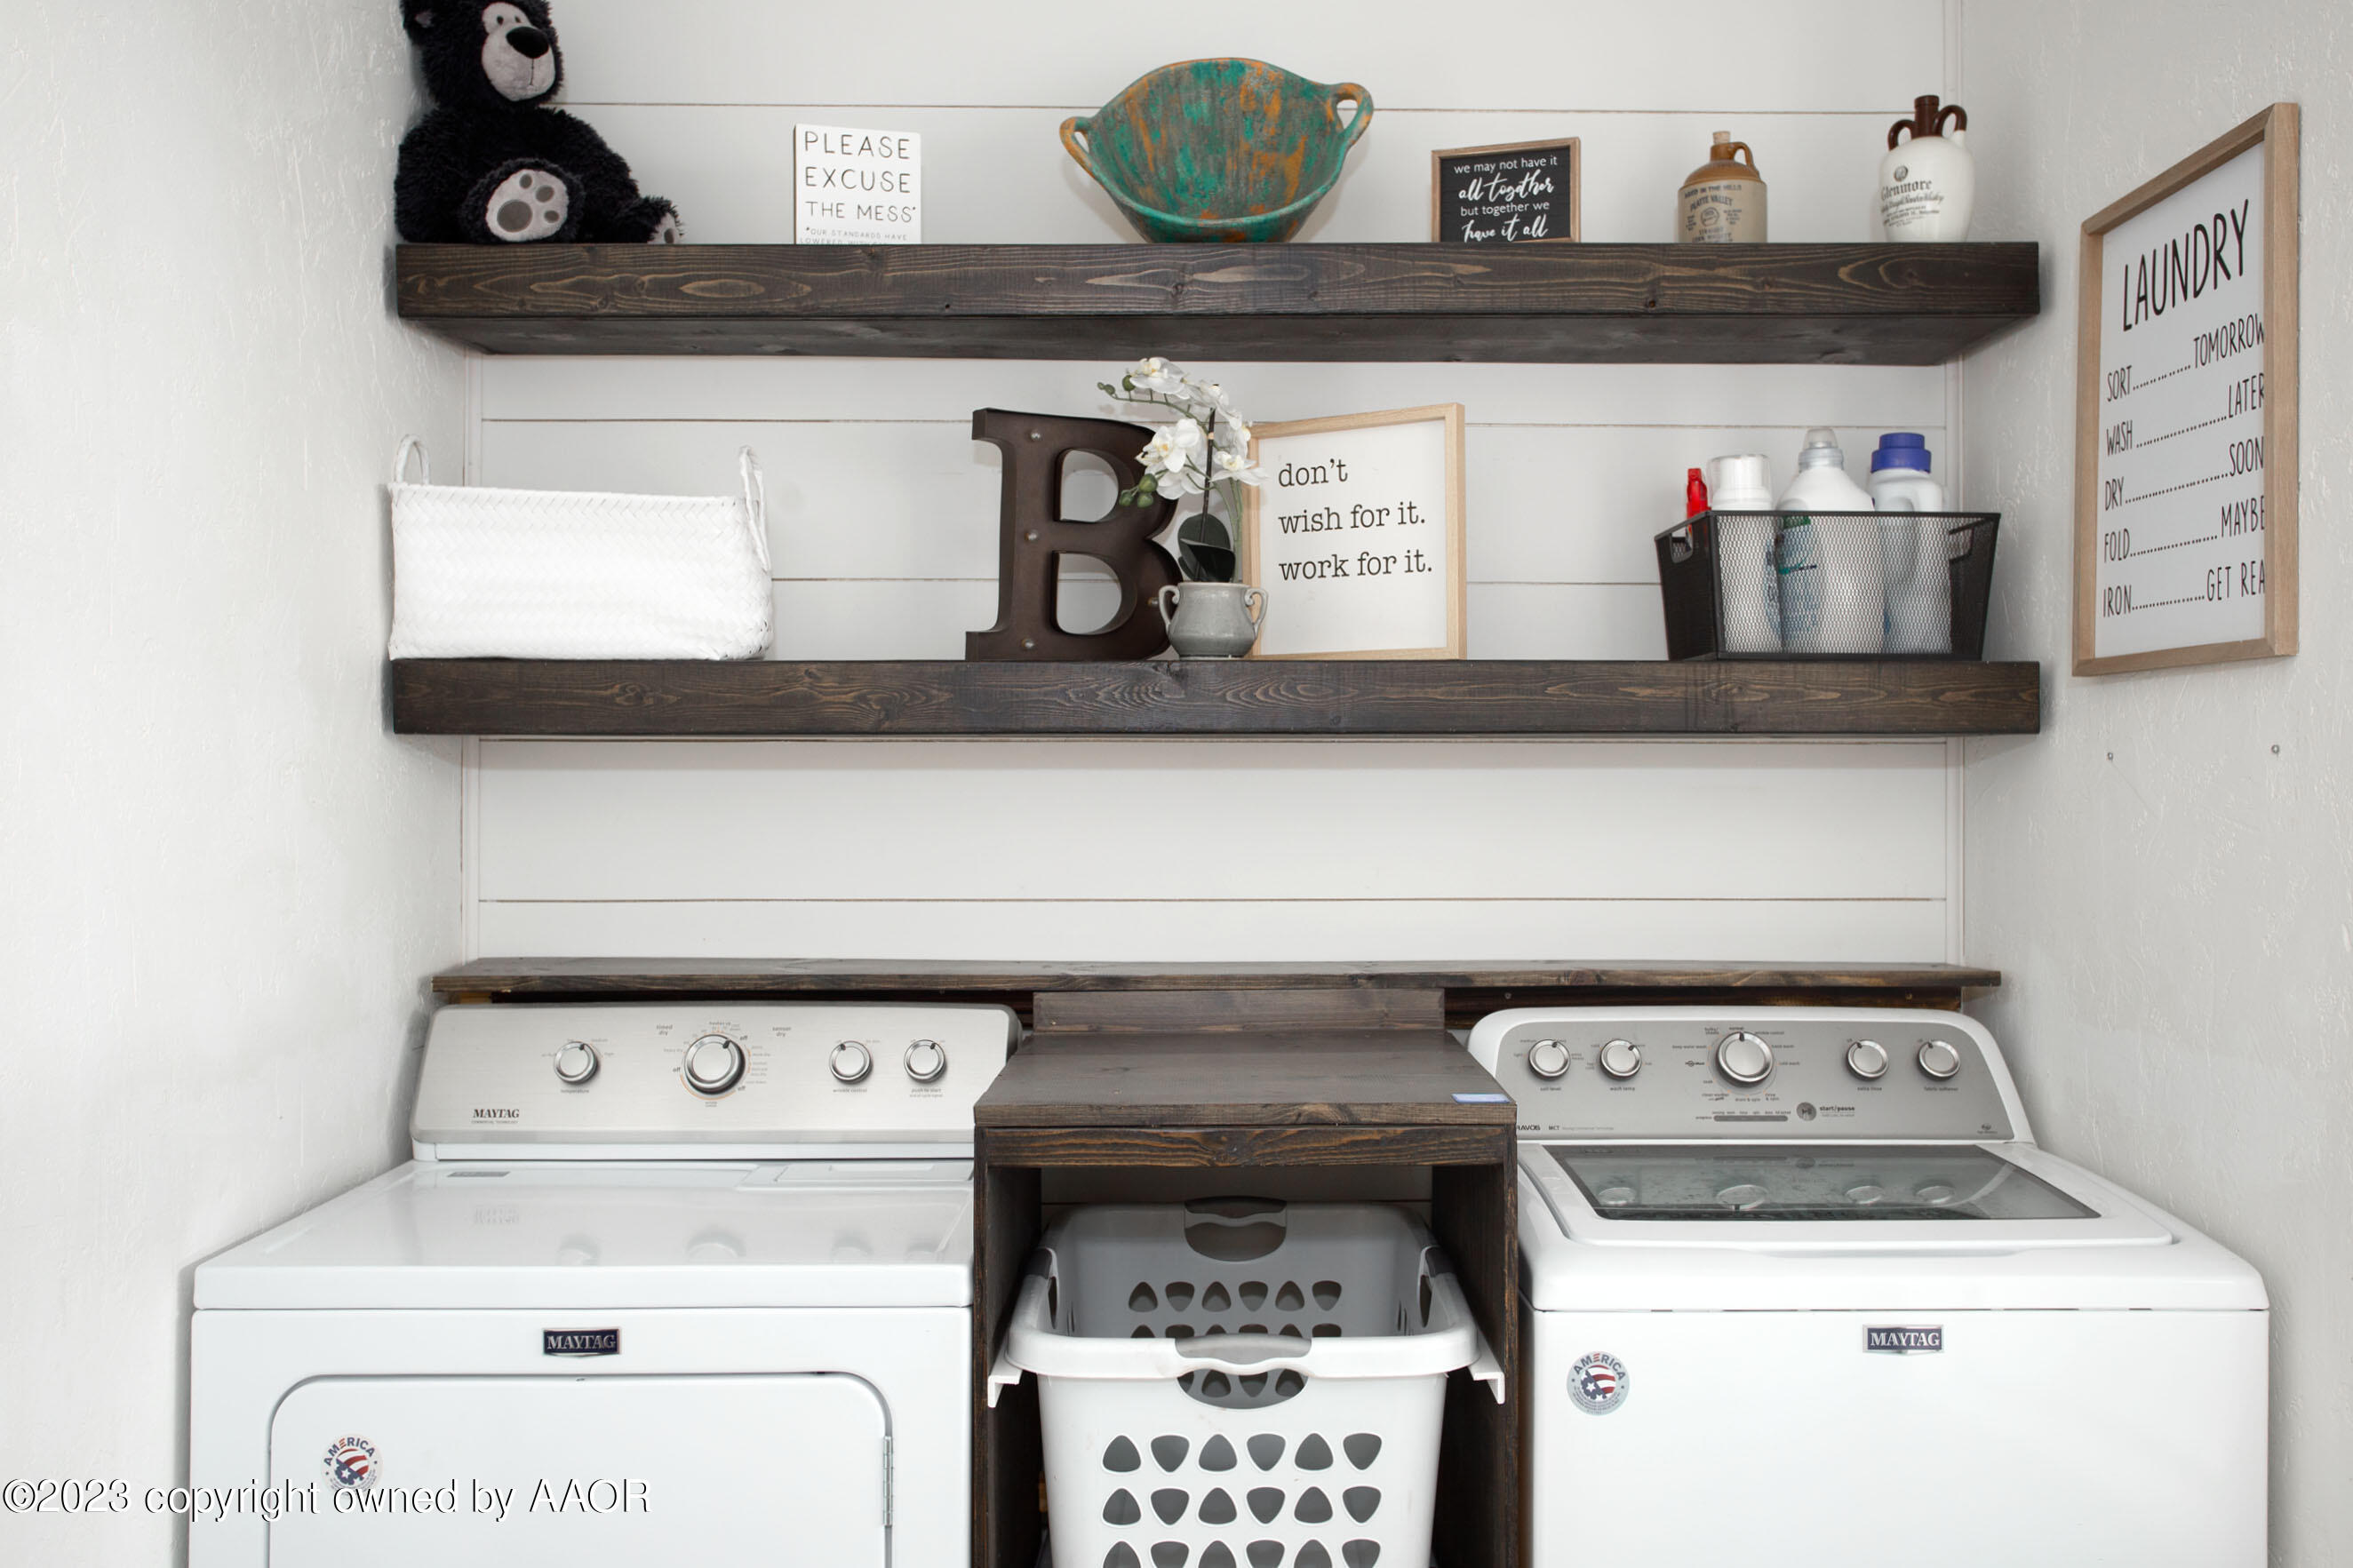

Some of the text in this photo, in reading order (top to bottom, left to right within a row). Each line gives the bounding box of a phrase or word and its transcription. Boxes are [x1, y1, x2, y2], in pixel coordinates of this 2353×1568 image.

[804, 131, 910, 159] PLEASE
[1454, 155, 1559, 174] we may not have it
[805, 166, 911, 194] EXCUSE
[1457, 169, 1555, 203] all together
[1880, 179, 1933, 202] Glenmore
[805, 201, 845, 219] THE
[1460, 201, 1551, 217] but together we
[1462, 213, 1549, 243] have it all
[2122, 197, 2250, 333] LAUNDRY
[2106, 312, 2265, 402] SORT TOMORROW
[2105, 419, 2134, 458] WASH
[2104, 434, 2265, 512] DRY SOON
[1278, 500, 1426, 535] wish for it.
[2103, 527, 2131, 564] FOLD
[1278, 548, 1433, 581] work for it.
[2102, 584, 2133, 618] IRON
[2205, 565, 2232, 602] GET
[473, 1108, 520, 1118] MAYTAG
[546, 1335, 616, 1349] MAYTAG
[1870, 1332, 1940, 1347] MAYTAG
[1573, 1352, 1626, 1381] AMERICA
[323, 1437, 375, 1467] AMERICA
